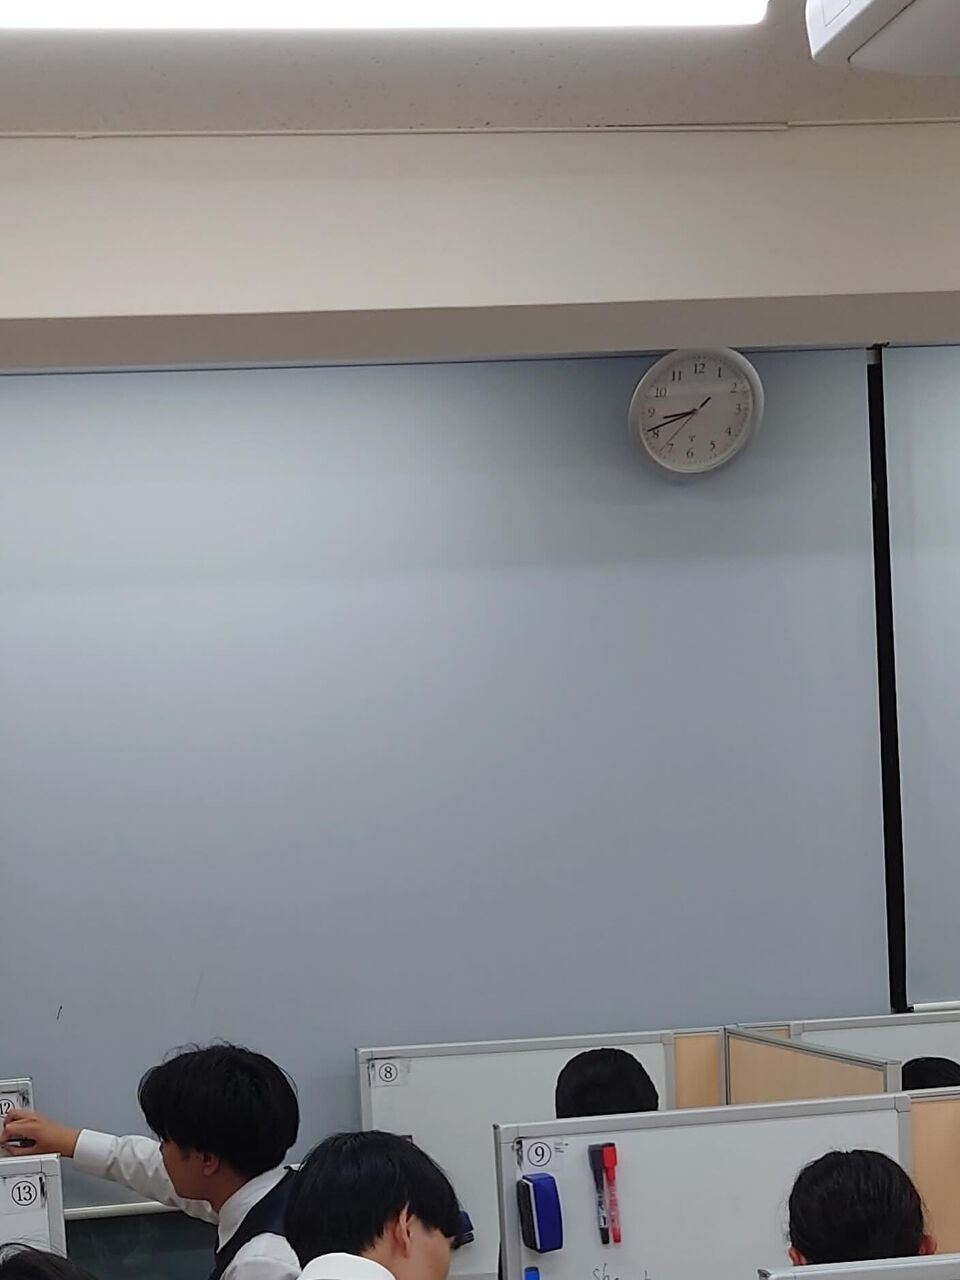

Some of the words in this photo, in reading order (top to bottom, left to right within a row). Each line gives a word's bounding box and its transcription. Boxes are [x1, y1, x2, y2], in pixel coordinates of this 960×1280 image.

[693, 362, 706, 375] 12
[717, 366, 723, 378] 1
[671, 370, 683, 382] 11
[654, 386, 668, 399] 10
[729, 382, 738, 394] 2
[647, 407, 656, 418] 9
[725, 426, 732, 437] 4
[667, 442, 675, 451] 7
[709, 440, 716, 452] 5
[685, 448, 695, 459] 6
